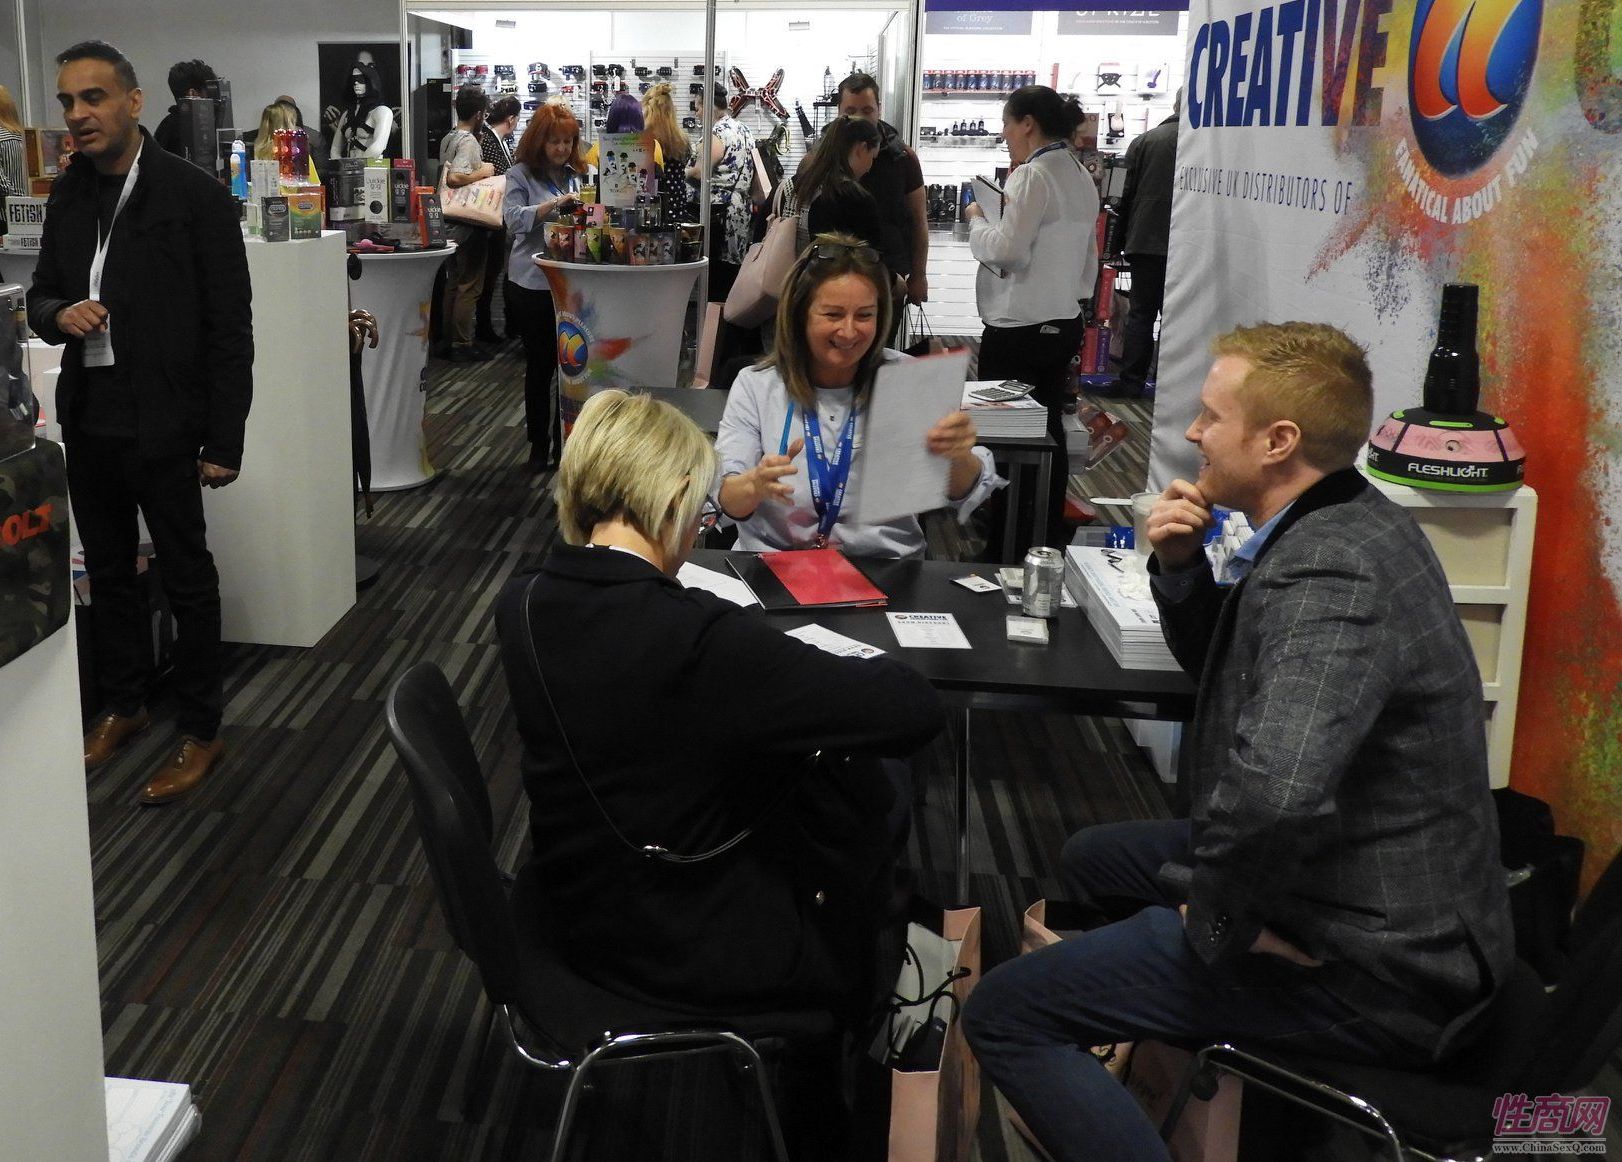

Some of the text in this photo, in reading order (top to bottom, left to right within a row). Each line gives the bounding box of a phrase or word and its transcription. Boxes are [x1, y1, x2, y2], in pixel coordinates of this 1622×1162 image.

[1187, 0, 1393, 130] CREATIVE
[1179, 166, 1353, 216] EXCLUSIVE UK DISTRIBUTORS OF
[1395, 126, 1540, 225] FANATICAL ABOUT FUN
[1407, 462, 1489, 478] FLESHLIGHT
[0, 503, 55, 549] OLT
